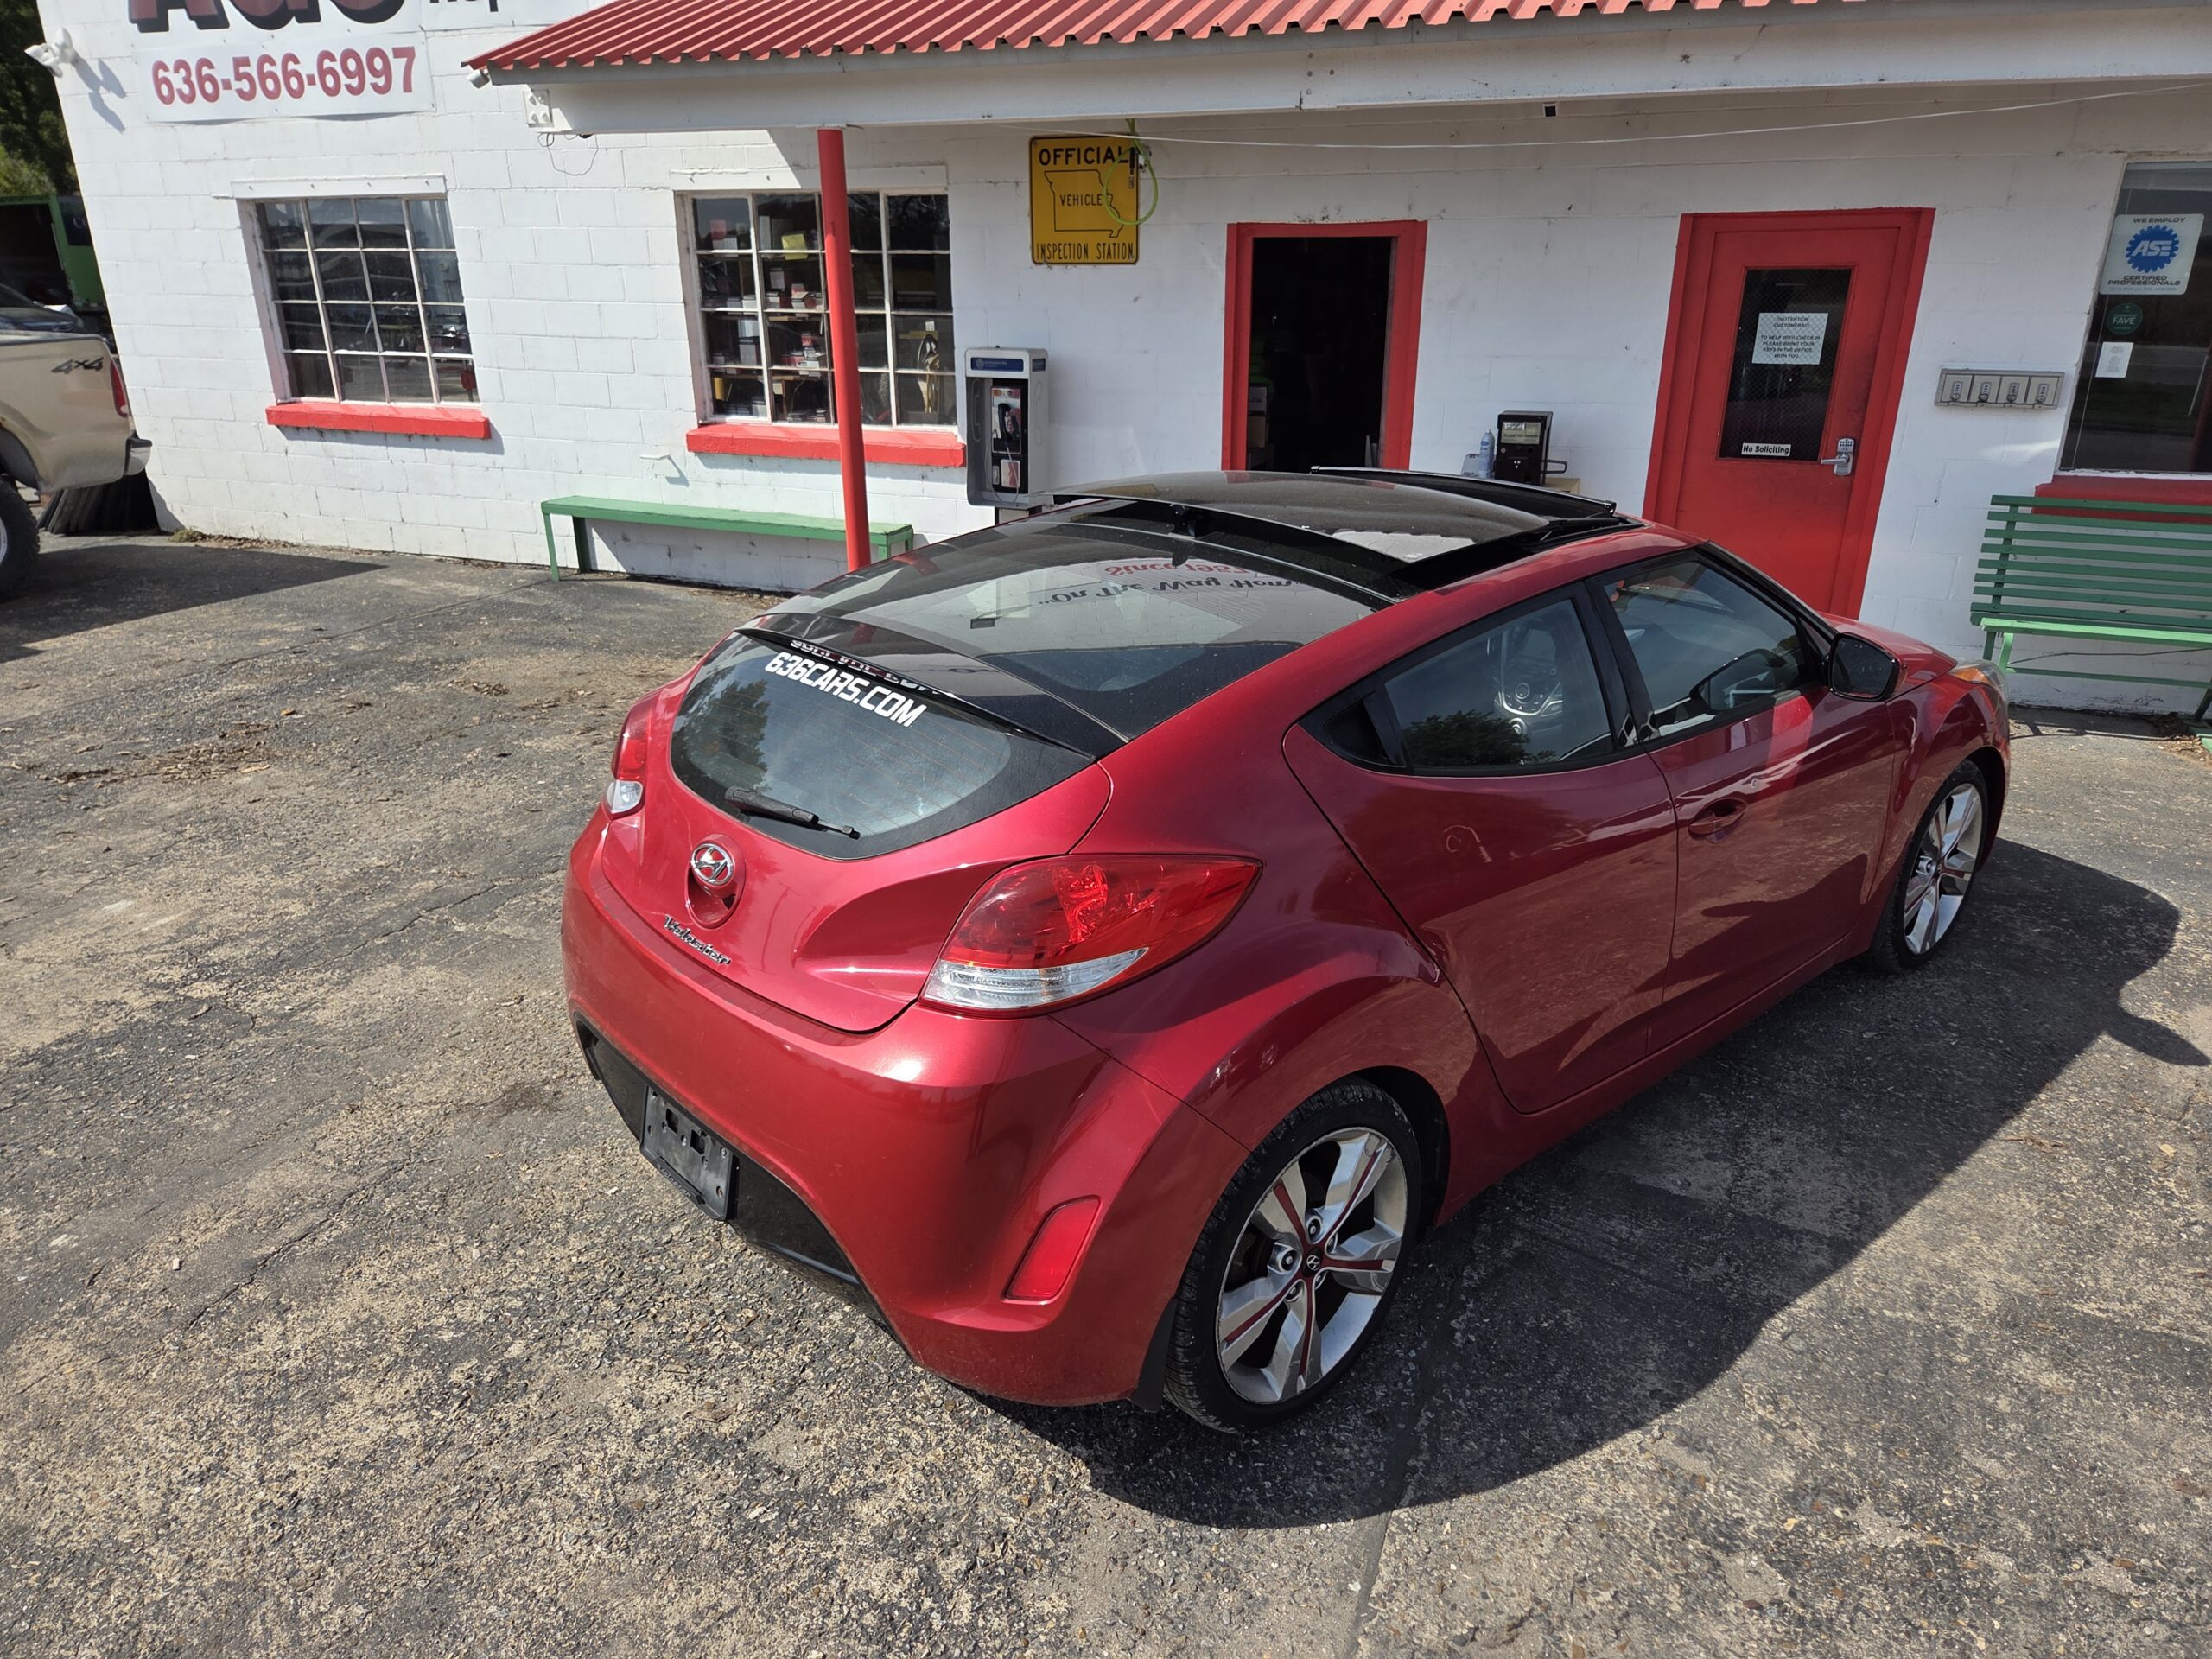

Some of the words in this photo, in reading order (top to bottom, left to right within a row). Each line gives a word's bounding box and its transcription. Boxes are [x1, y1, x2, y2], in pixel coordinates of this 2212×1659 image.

[151, 46, 416, 106] 636-566-6997
[1039, 146, 1129, 166] OFFICIAL
[1059, 194, 1103, 206] VEHICLE
[1036, 243, 1089, 260] INSPECTION
[1096, 242, 1134, 260] STATION
[2131, 240, 2173, 257] ASE
[2112, 316, 2137, 325] FAVE
[51, 357, 105, 375] 4x4
[1755, 445, 1789, 455] Soliciting
[765, 652, 927, 728] 636CARS.COM
[664, 913, 732, 966] Veloster
